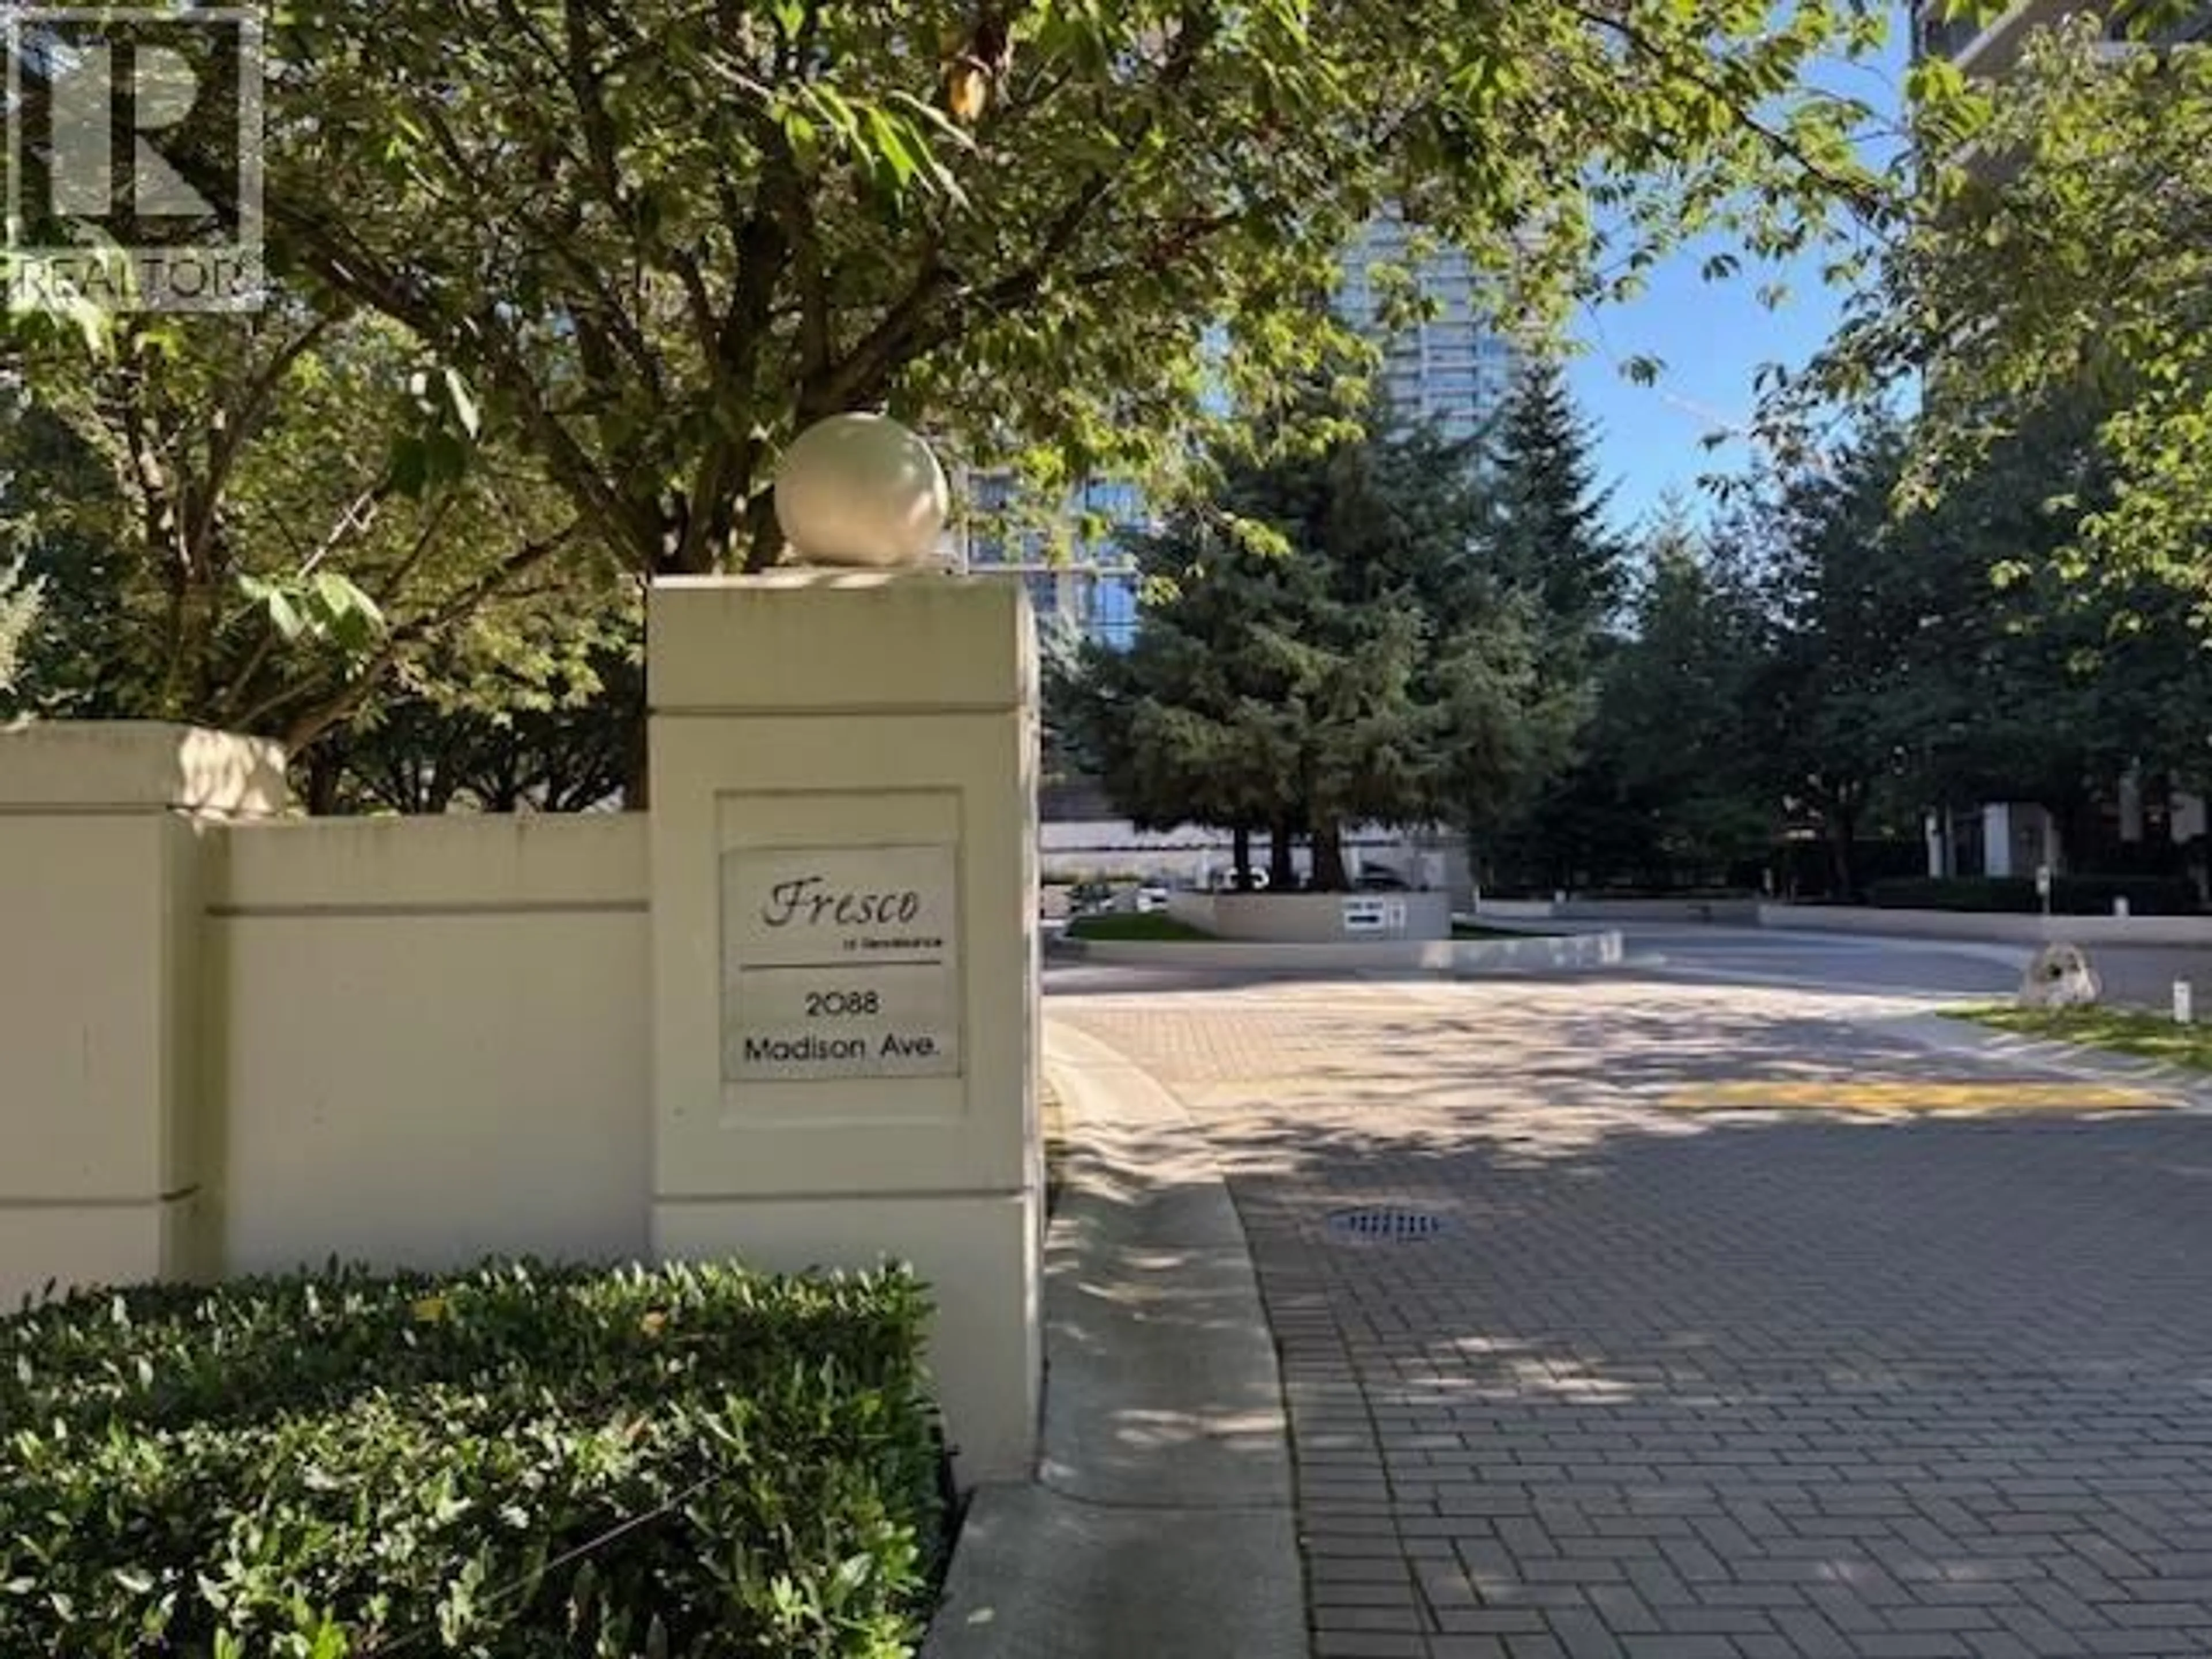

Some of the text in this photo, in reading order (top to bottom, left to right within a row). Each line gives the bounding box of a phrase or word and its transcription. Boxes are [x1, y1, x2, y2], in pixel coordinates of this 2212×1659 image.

[762, 876, 920, 927] Fresco
[806, 991, 879, 1016] 2088
[745, 1033, 940, 1061] Madison Ave.
